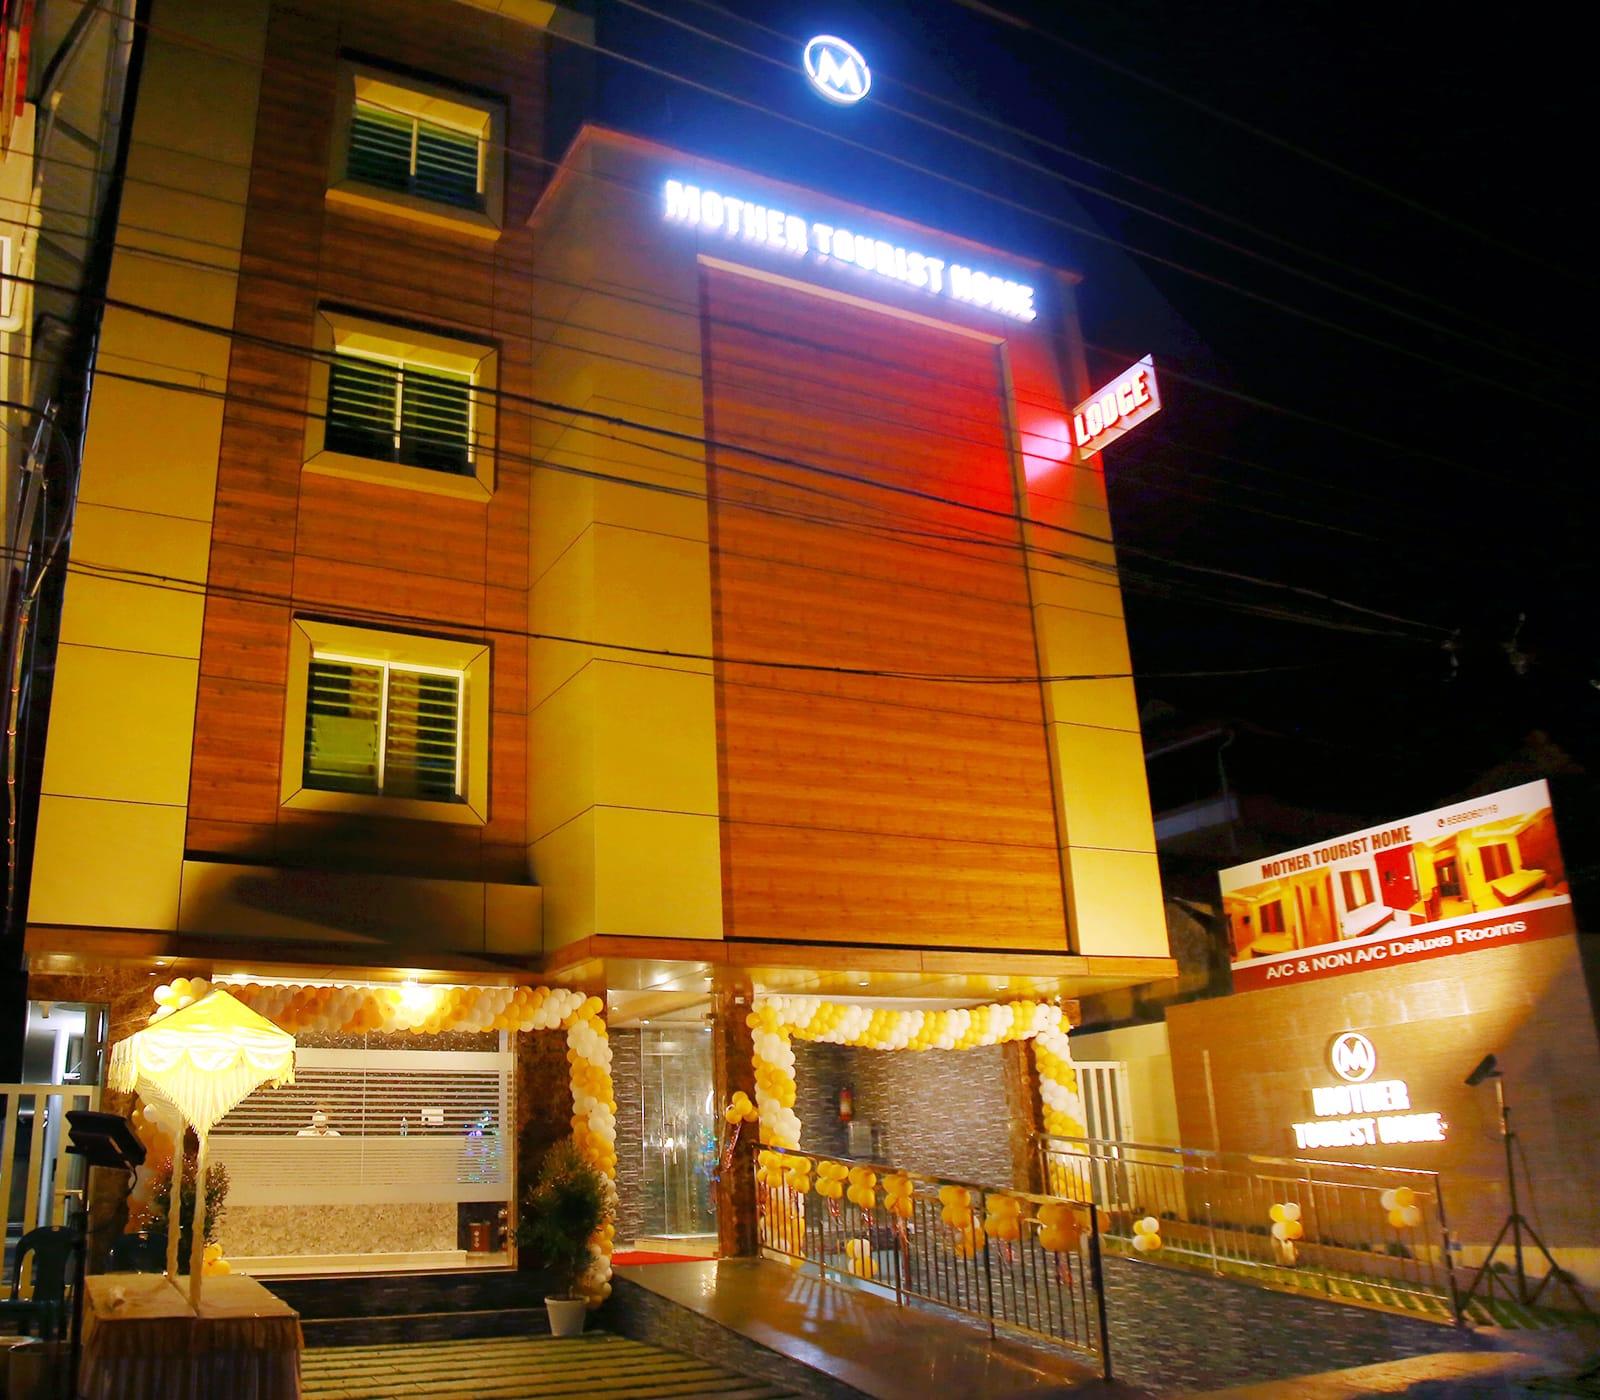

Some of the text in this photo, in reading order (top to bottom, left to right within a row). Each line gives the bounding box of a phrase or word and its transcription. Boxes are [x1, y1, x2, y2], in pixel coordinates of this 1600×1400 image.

[666, 179, 1037, 322] MOTHER TOURIST HOME
[1073, 370, 1151, 447] LODGE
[1261, 825, 1412, 879] MOTHER TOURIST HOME
[1266, 921, 1527, 979] A/C & NON A/C Deluxe Rooms
